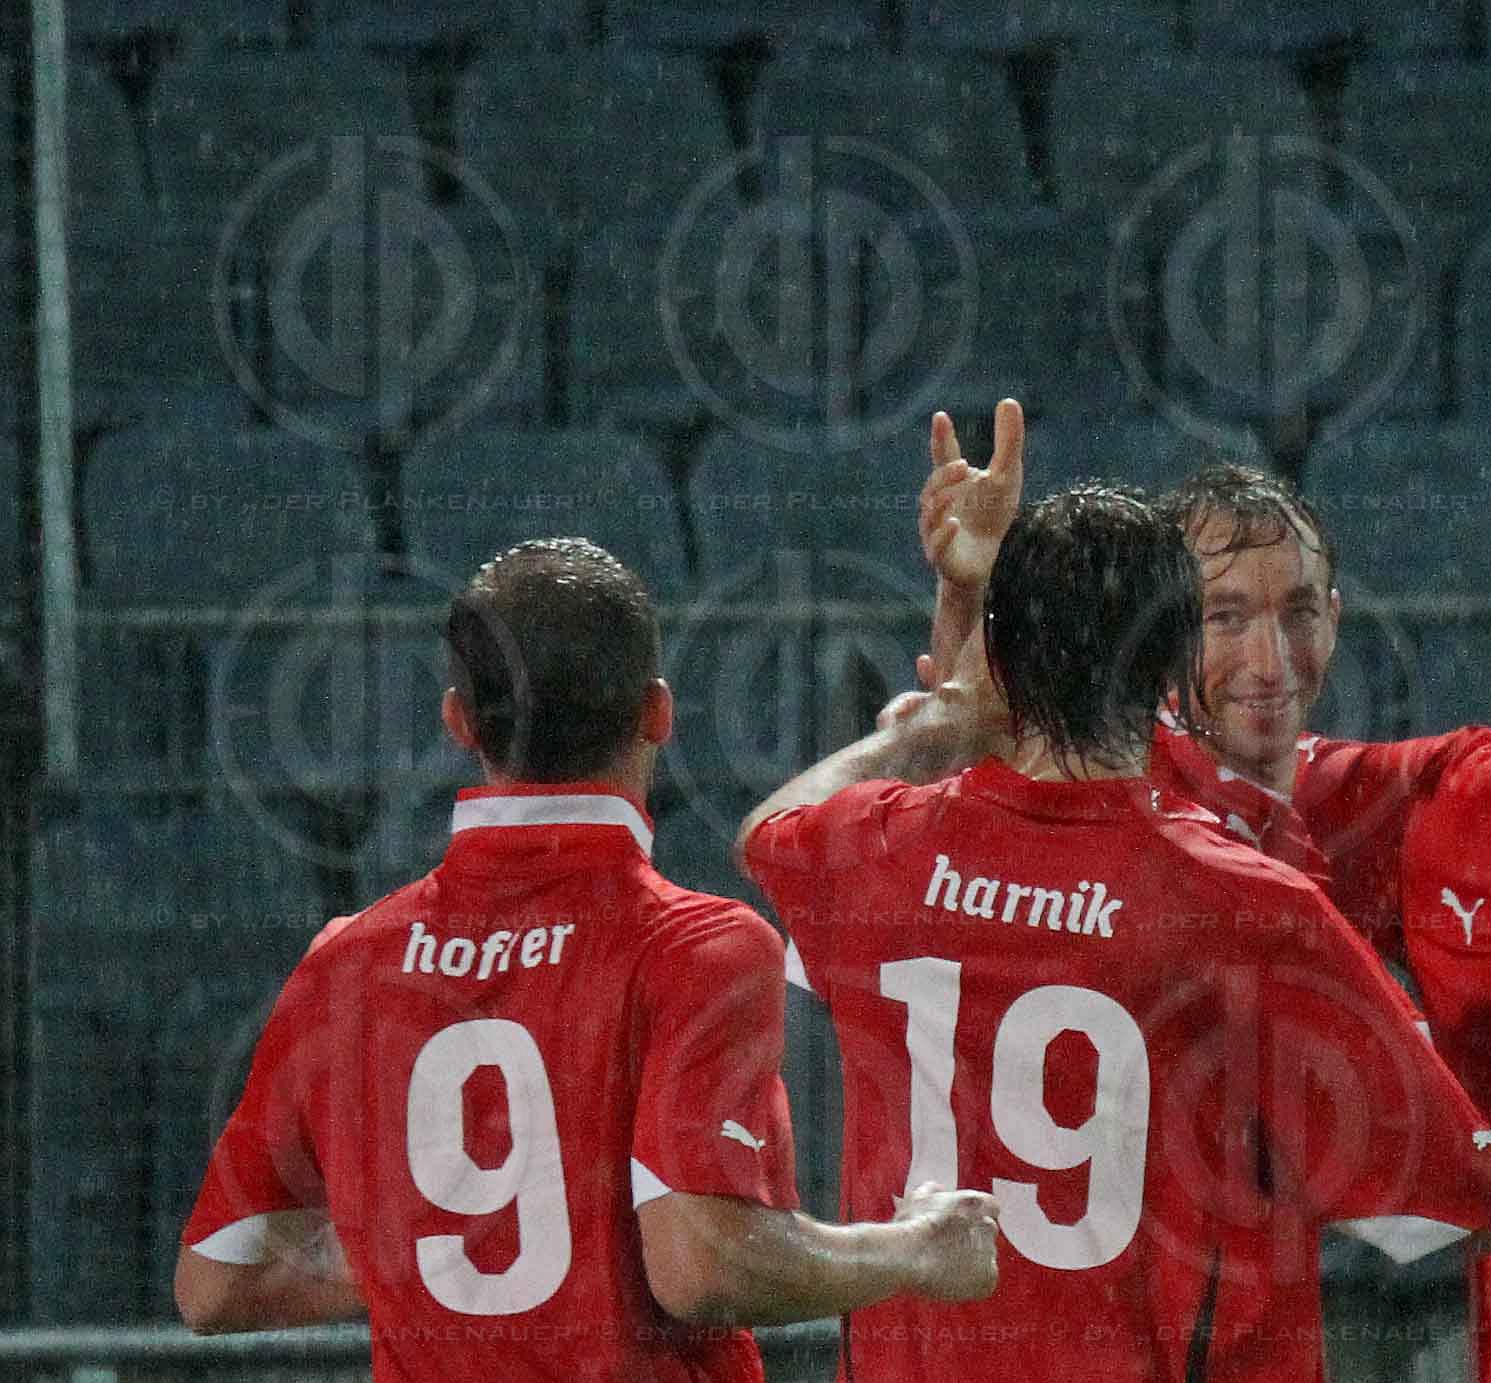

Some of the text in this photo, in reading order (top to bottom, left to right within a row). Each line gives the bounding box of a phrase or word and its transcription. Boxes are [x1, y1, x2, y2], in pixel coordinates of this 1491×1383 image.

[401, 923, 576, 981] hofer
[923, 855, 1123, 939] harnik
[406, 1018, 573, 1316] 9
[879, 956, 1151, 1270] 19
